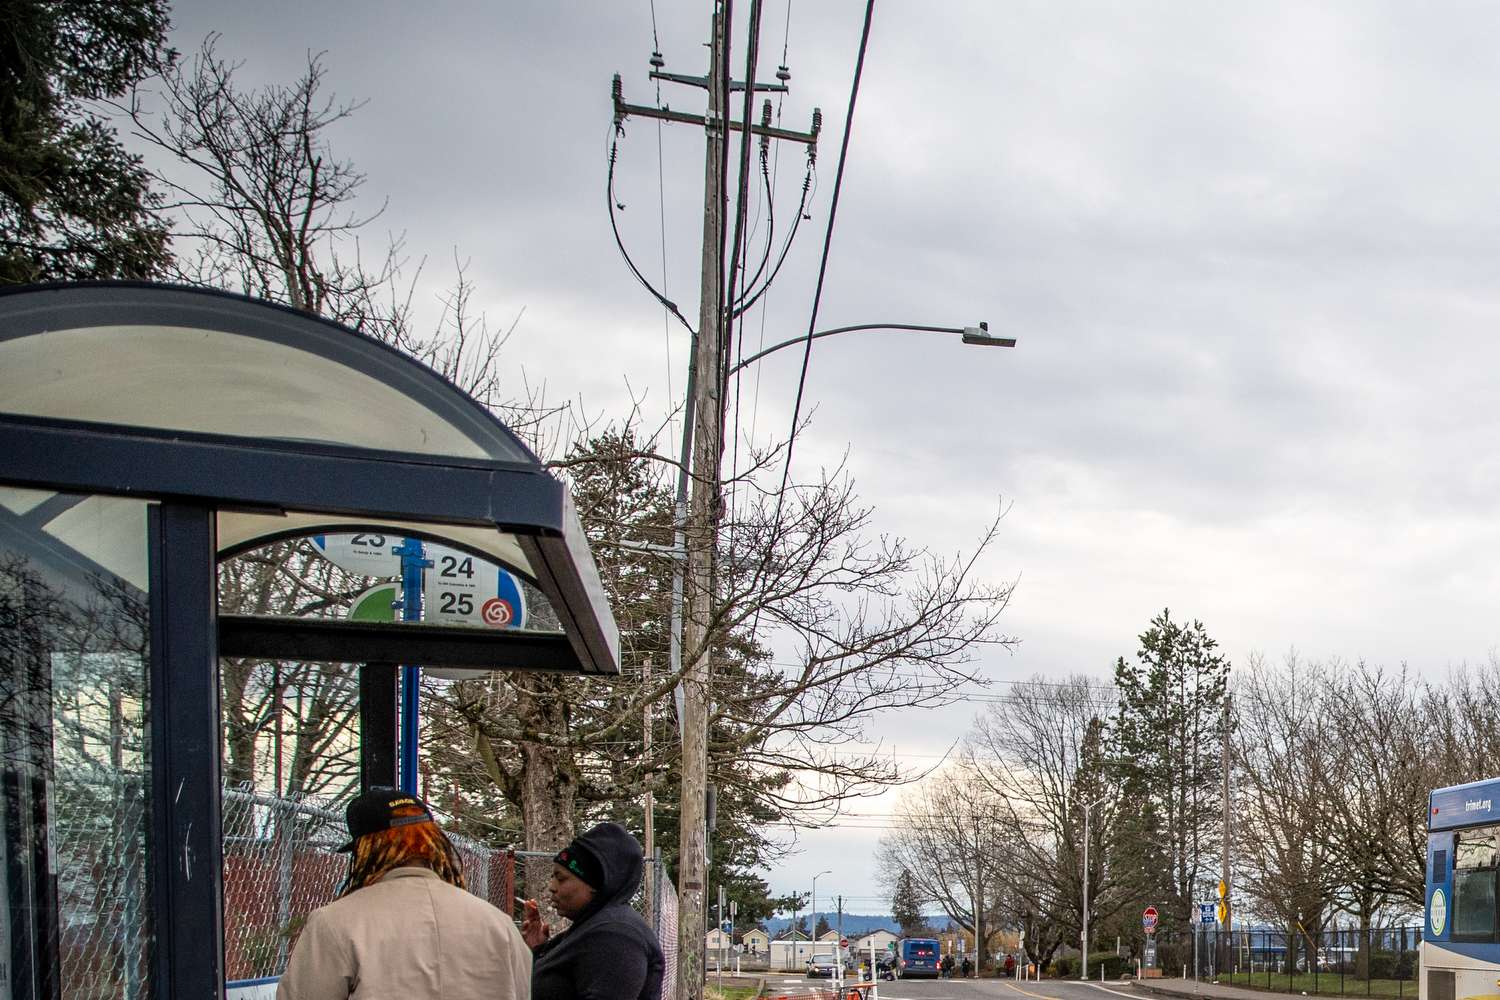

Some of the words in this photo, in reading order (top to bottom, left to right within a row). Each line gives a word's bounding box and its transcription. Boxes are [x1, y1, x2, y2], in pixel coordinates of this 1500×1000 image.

[440, 555, 475, 579] 24
[440, 591, 474, 616] 25
[1465, 799, 1492, 812] trimet.org
